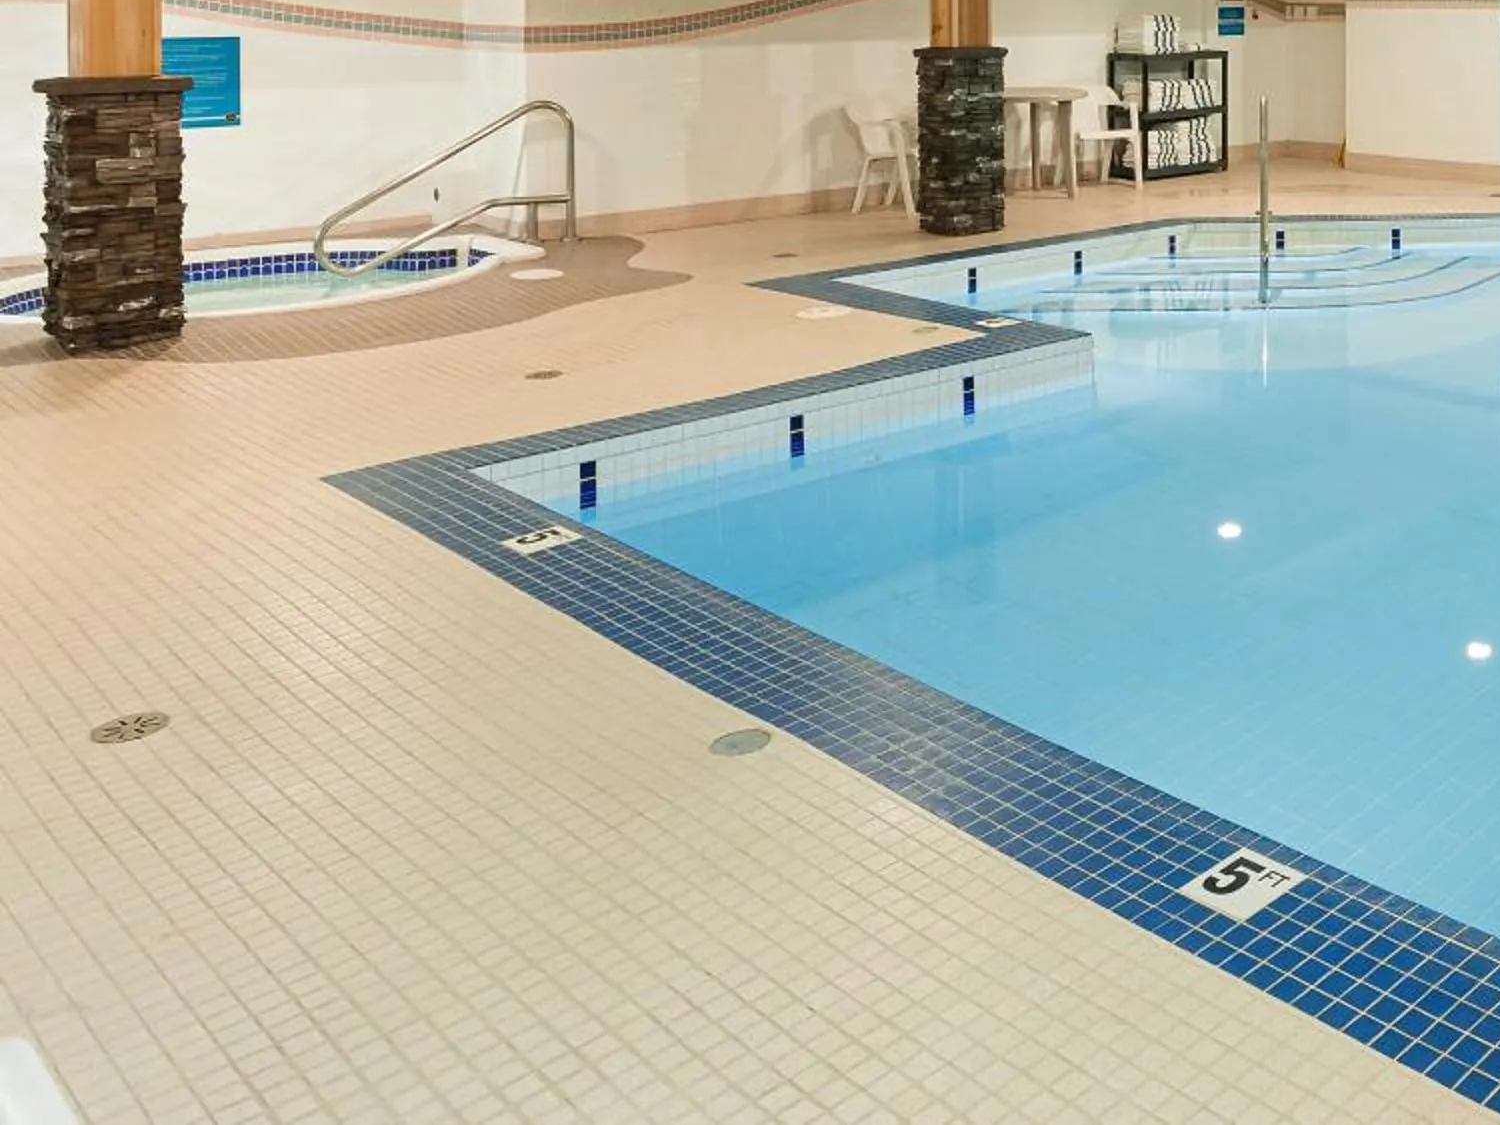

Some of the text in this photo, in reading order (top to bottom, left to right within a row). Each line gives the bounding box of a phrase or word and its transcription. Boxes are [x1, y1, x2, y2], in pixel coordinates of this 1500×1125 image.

[516, 528, 560, 545] 5
[1202, 856, 1291, 895] 5 FT
